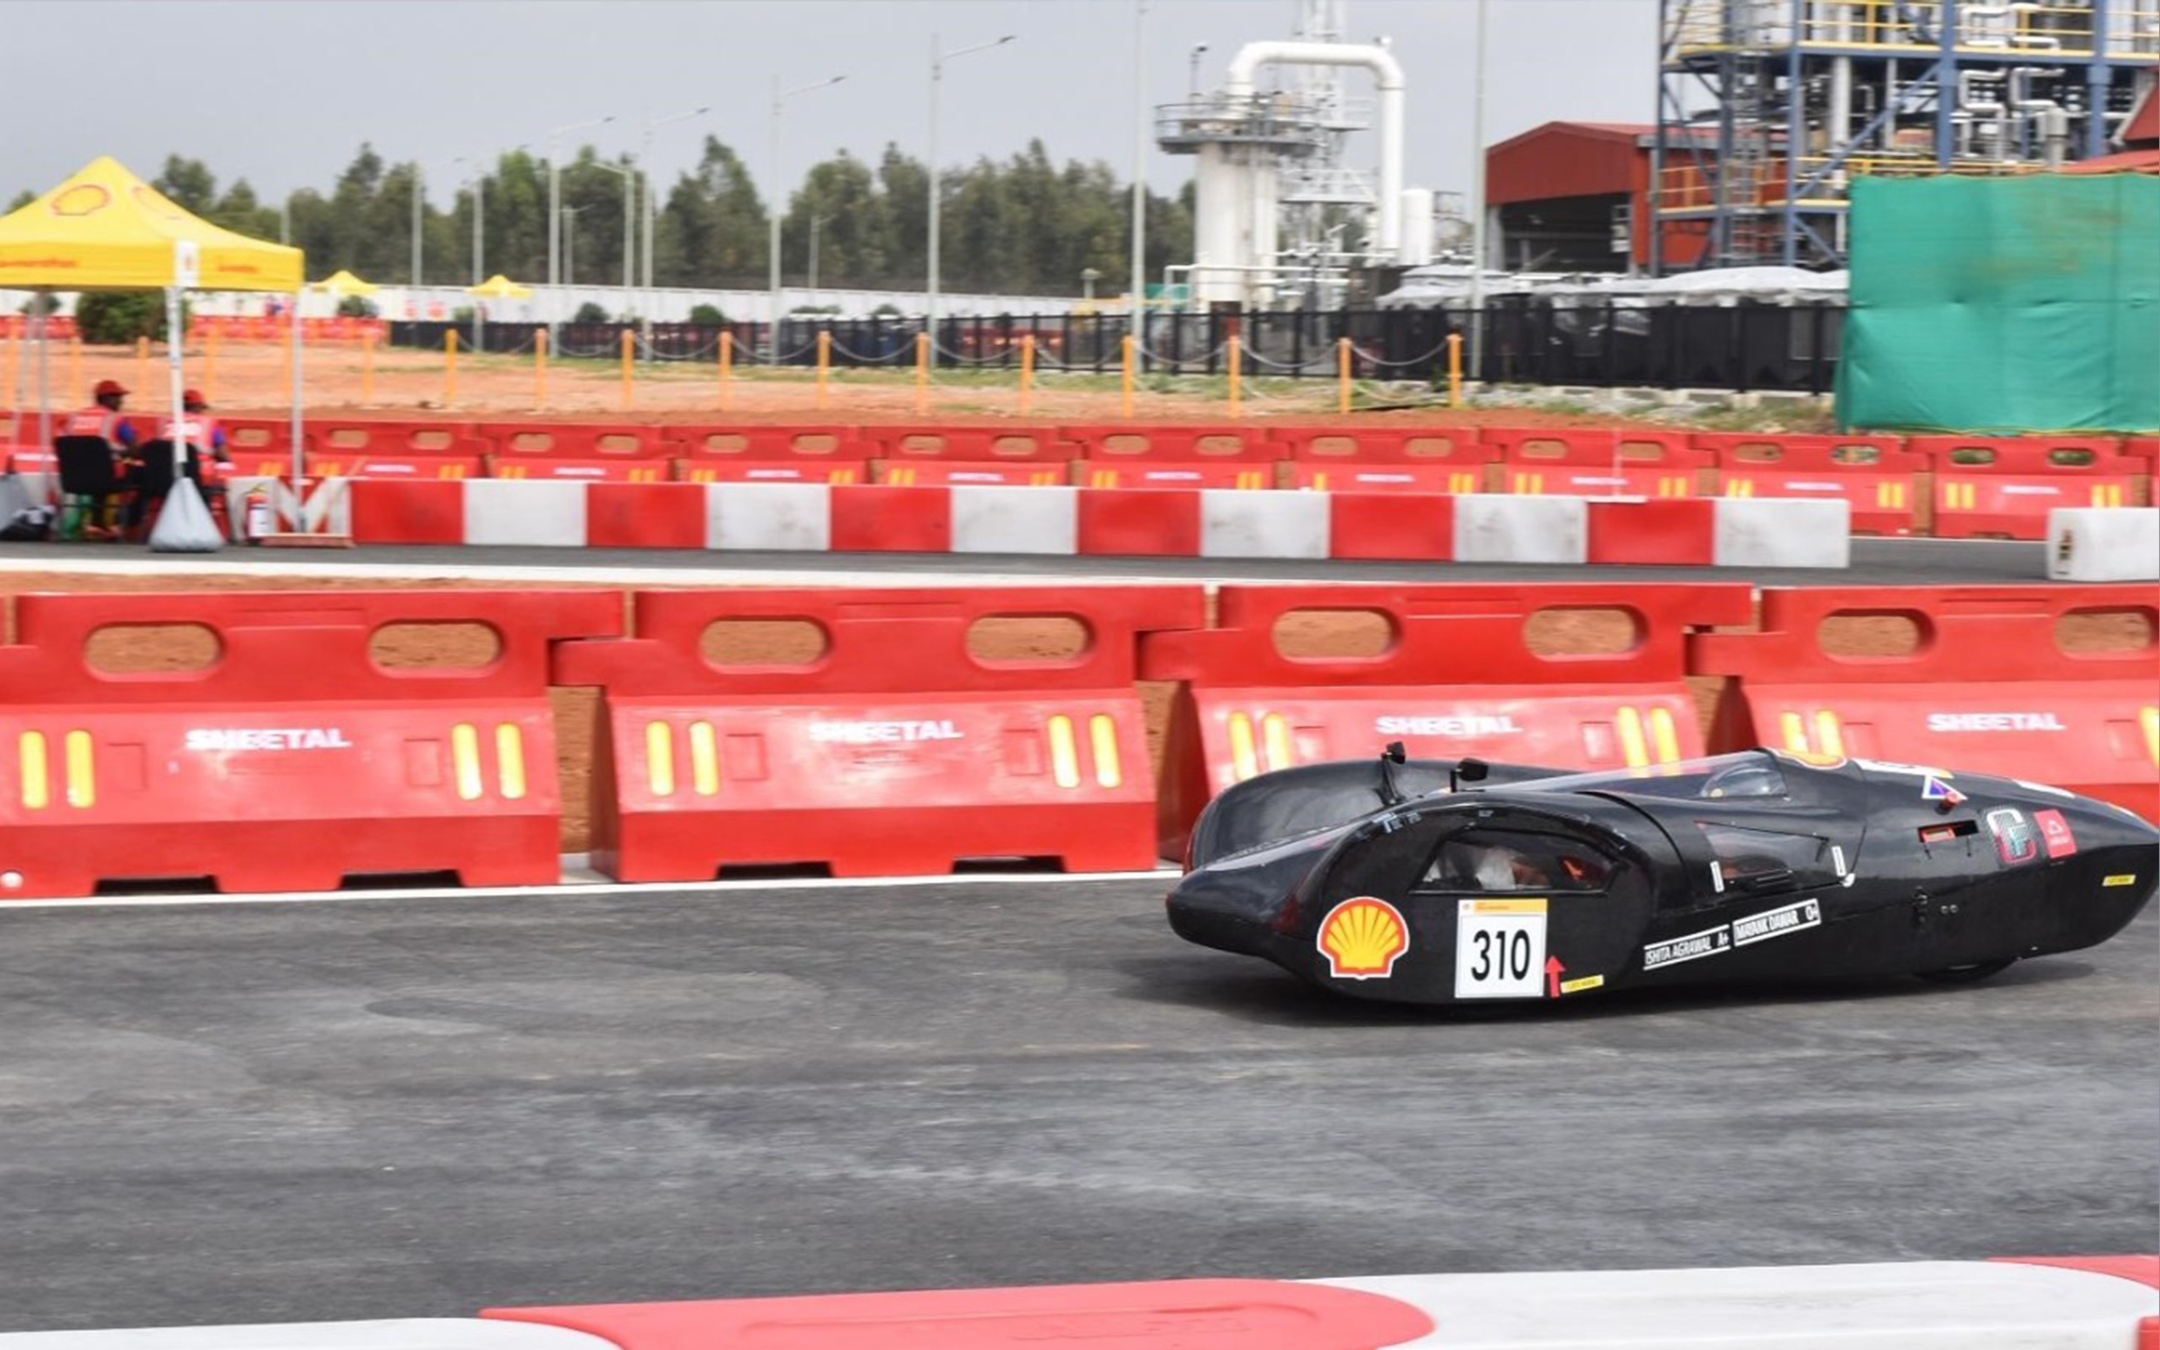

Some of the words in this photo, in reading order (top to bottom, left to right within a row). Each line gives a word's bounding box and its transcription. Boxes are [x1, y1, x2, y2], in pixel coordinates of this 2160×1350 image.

[1927, 713, 2067, 731] SHEETAL
[186, 729, 352, 749] SHEETAL
[1736, 919, 1769, 940] MAYANK
[1471, 929, 1530, 981] 310
[1645, 947, 1671, 965] ISHITA
[1673, 937, 1712, 957] AGRAWAL
[1717, 932, 1729, 947] A+
